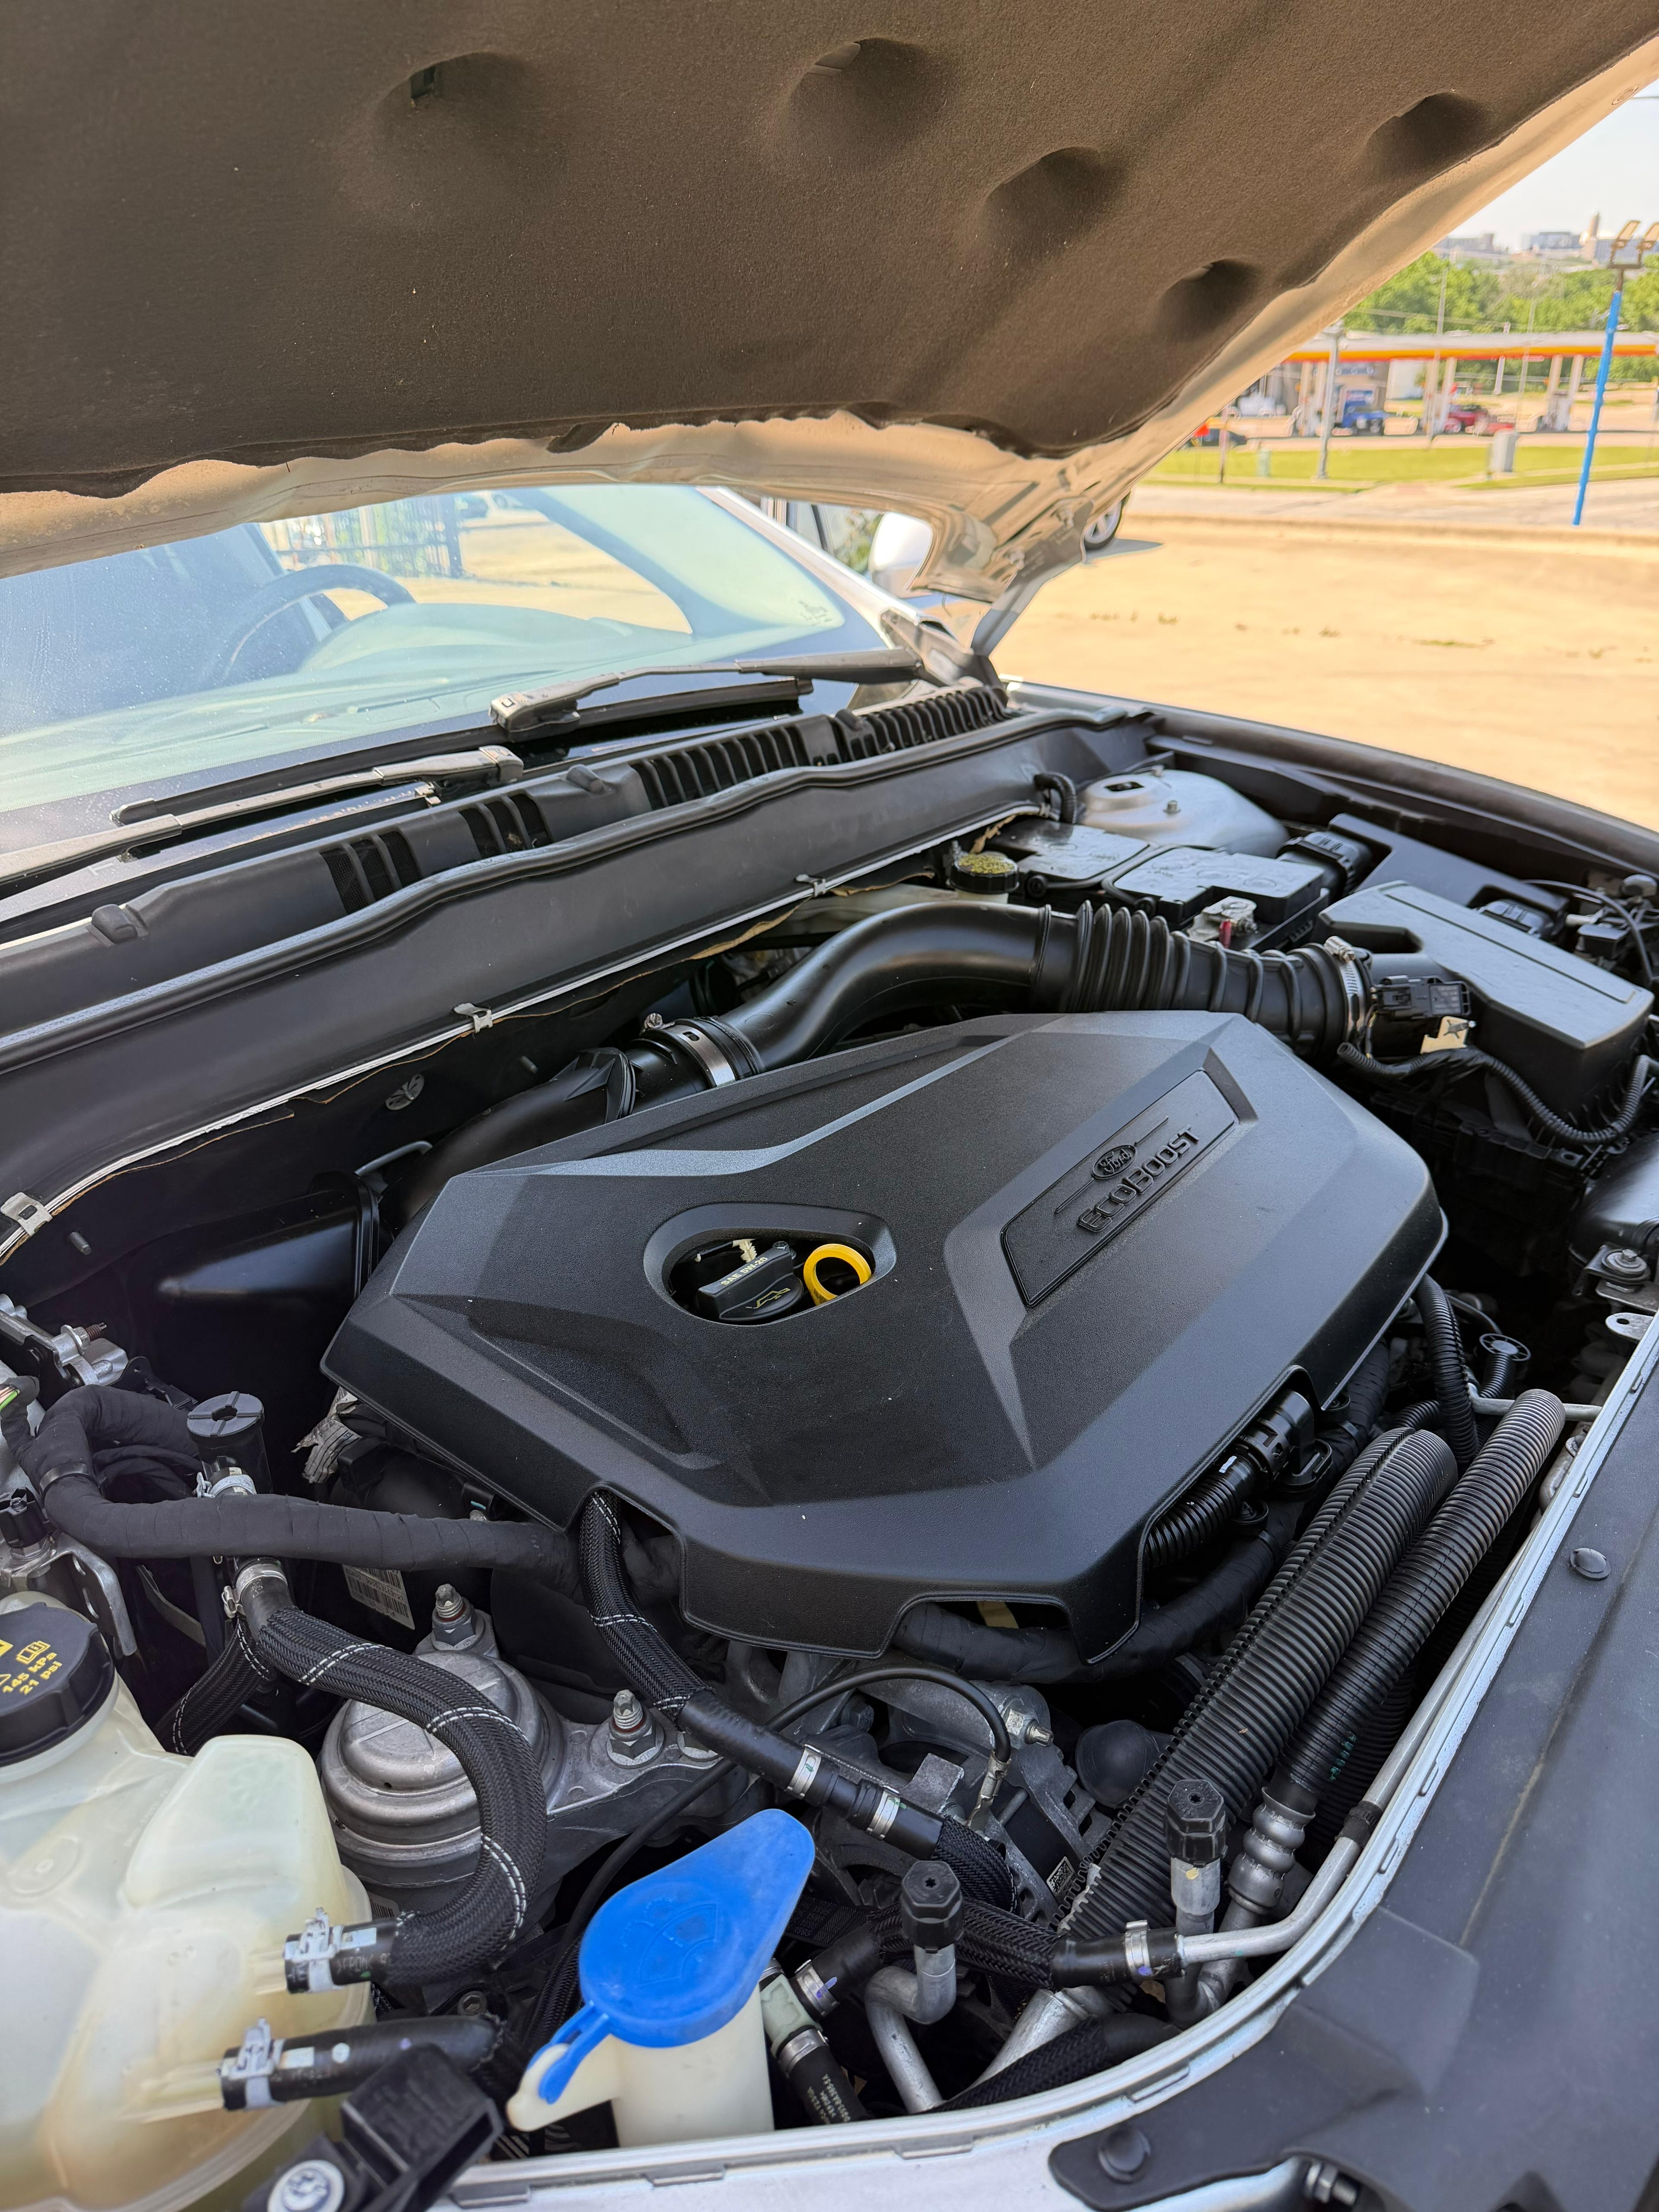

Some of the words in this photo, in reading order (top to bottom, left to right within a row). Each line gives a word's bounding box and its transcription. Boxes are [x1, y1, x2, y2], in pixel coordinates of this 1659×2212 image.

[1098, 1148, 1132, 1175] Ford
[1077, 1124, 1199, 1232] ECOBOOST
[720, 1273, 743, 1285] SAE
[740, 1257, 768, 1274] 5W-20
[3, 1672, 29, 1693] 145
[19, 1679, 39, 1696] 21
